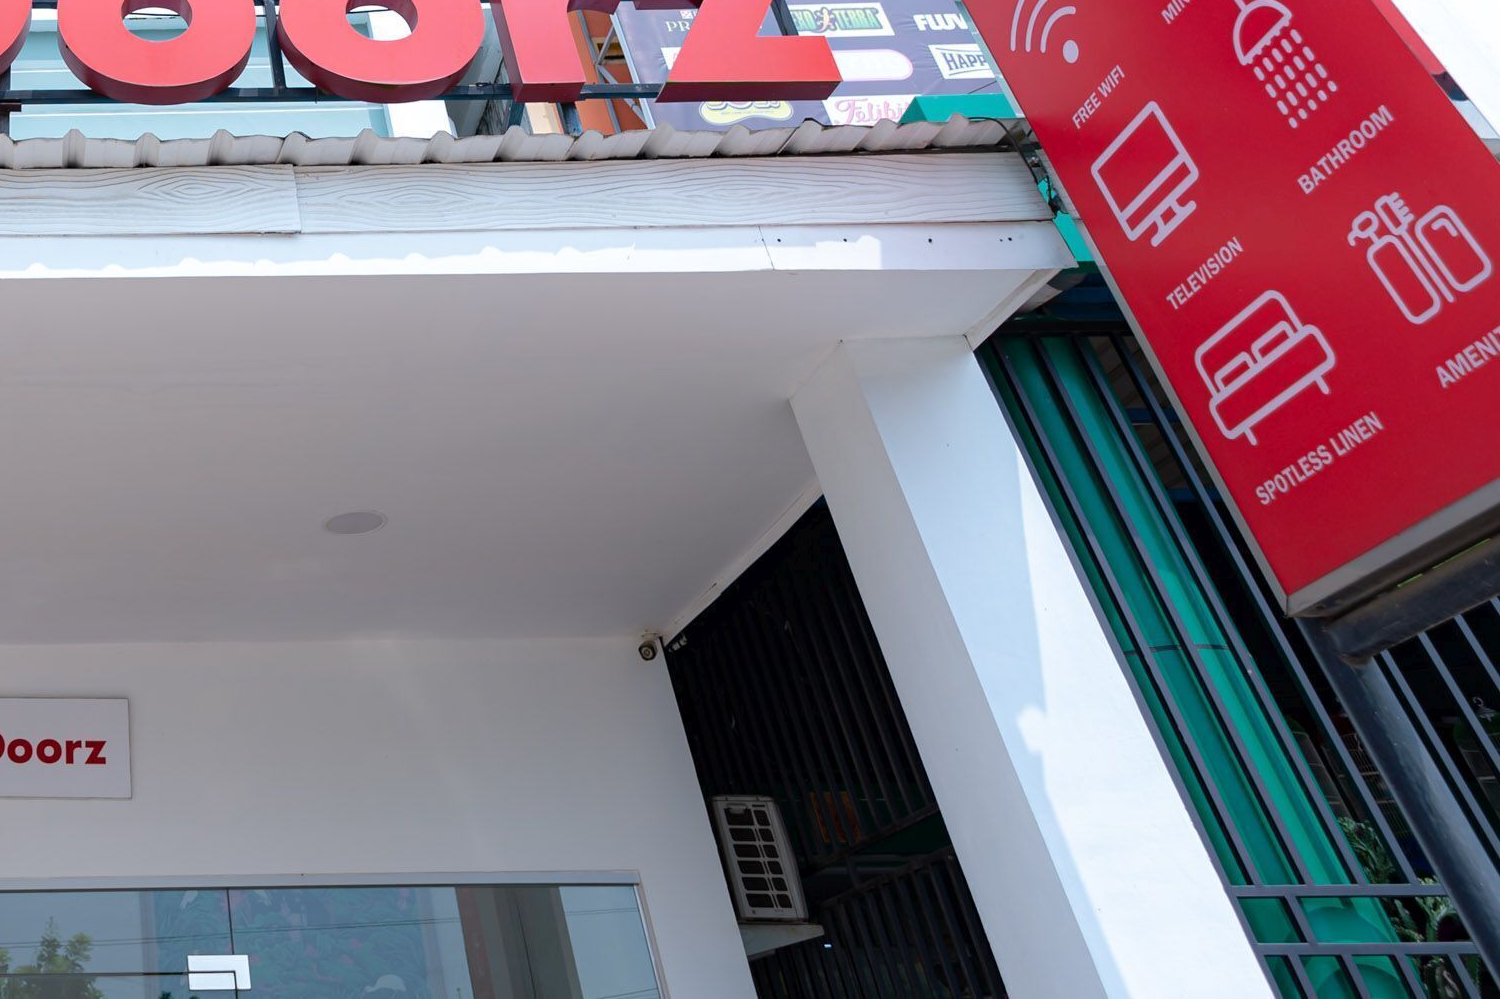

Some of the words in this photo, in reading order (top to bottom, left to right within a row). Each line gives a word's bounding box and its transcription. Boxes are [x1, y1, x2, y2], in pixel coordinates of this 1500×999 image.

[1072, 92, 1101, 129] FREE
[1097, 65, 1125, 97] WIFI
[1297, 105, 1394, 195] BATHROOM
[1166, 237, 1244, 310] TELEVISION
[1255, 444, 1333, 505] SPOTLESS
[1329, 410, 1384, 456] LINEN
